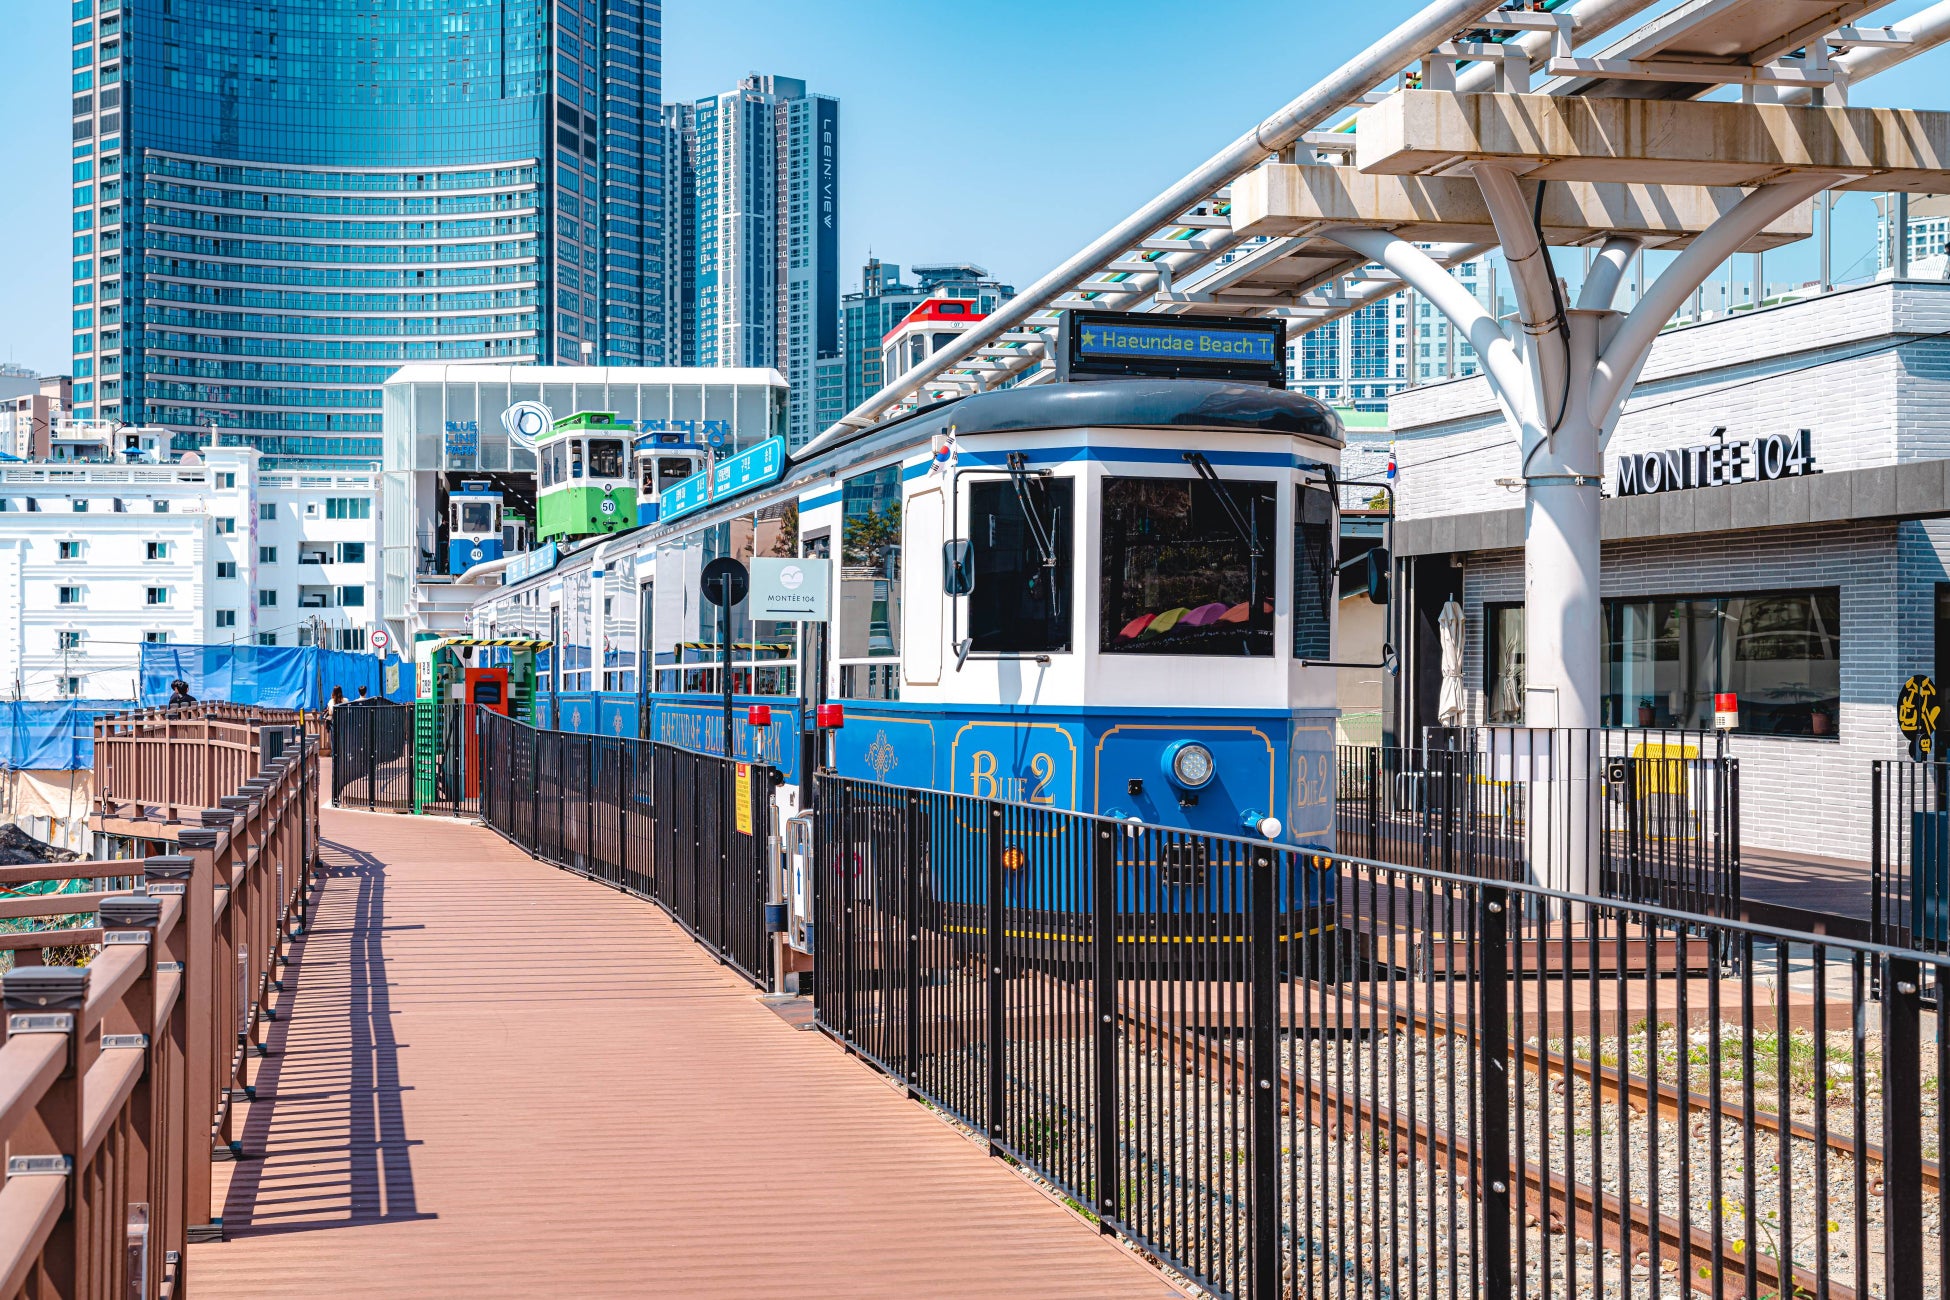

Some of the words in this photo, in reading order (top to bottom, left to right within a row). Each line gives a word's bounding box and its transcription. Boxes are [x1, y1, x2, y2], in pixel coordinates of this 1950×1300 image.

[1103, 331, 1194, 351] Haeundae
[1200, 336, 1253, 354] Beach
[446, 421, 478, 432] BLUE
[446, 433, 478, 444] LINE
[446, 445, 478, 456] PARK
[602, 502, 615, 512] 50
[471, 551, 482, 559] 40
[1030, 752, 1056, 806] 2
[1318, 754, 1328, 805] 2
